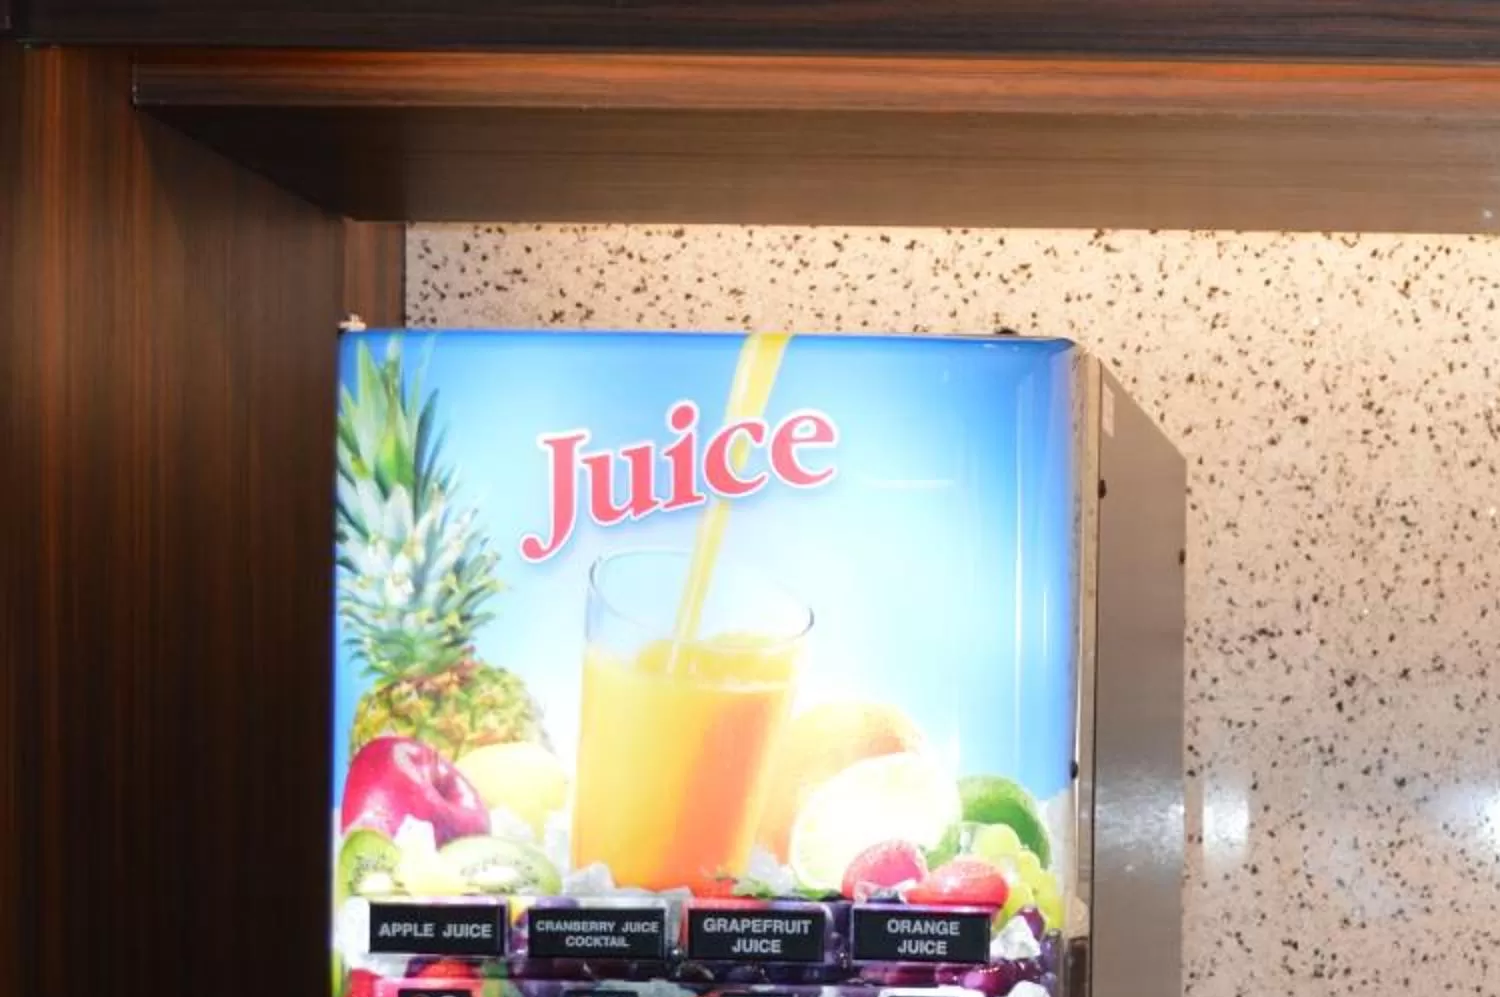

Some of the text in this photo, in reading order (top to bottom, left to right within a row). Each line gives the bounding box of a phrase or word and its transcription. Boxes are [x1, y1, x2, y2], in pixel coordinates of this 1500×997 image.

[521, 402, 836, 561] Juice
[378, 921, 493, 939] APPLE JUICE
[535, 919, 660, 934] CRANBERRY JUICE
[703, 917, 813, 934] GRAPEFRUIT
[887, 918, 961, 936] ORANGE
[564, 935, 630, 948] COCKTAIL
[732, 938, 782, 954] JUICE
[897, 939, 948, 955] JUICE
